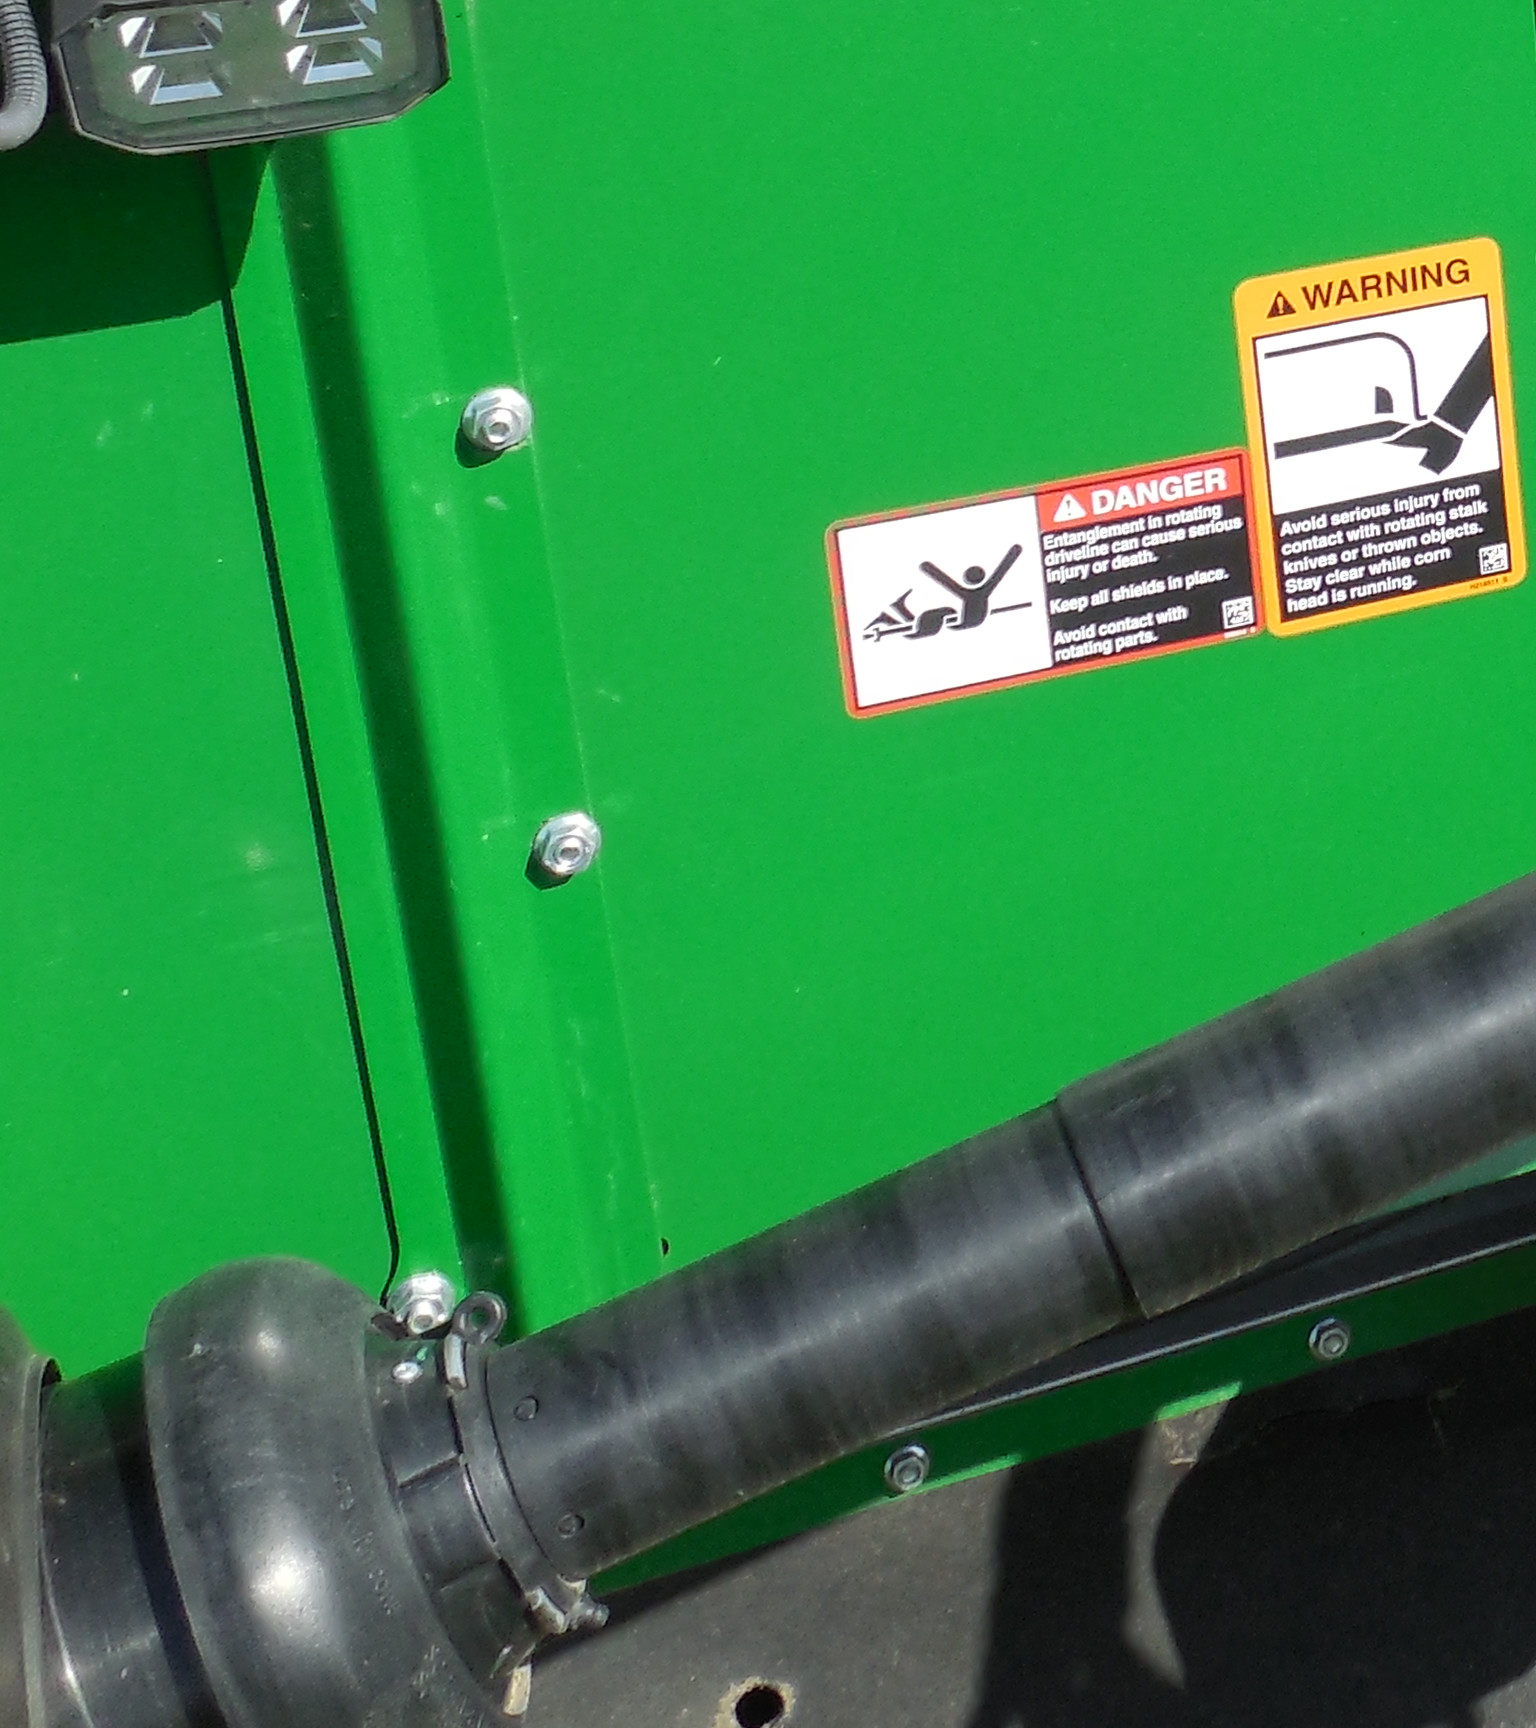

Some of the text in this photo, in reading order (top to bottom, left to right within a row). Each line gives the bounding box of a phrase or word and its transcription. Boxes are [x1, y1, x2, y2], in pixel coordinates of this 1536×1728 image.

[1301, 258, 1471, 312] WARNING
[1092, 467, 1227, 515] DANGER
[1280, 484, 1480, 537] Avoid serious injury from
[1043, 504, 1223, 550] Entanglement in rotating
[1045, 516, 1243, 566] driveline can cause serious
[1282, 499, 1488, 556] contact with rotating stalk
[1284, 522, 1483, 575] knives or thrown objects.
[1047, 550, 1159, 584] injury or death.
[1285, 548, 1450, 594] Stay clear while corn
[1050, 568, 1229, 615] Keep all shields in place.
[1287, 574, 1418, 613] head is running.
[1054, 605, 1188, 646] Avoid contact with
[1055, 631, 1158, 662] rotating parts.
